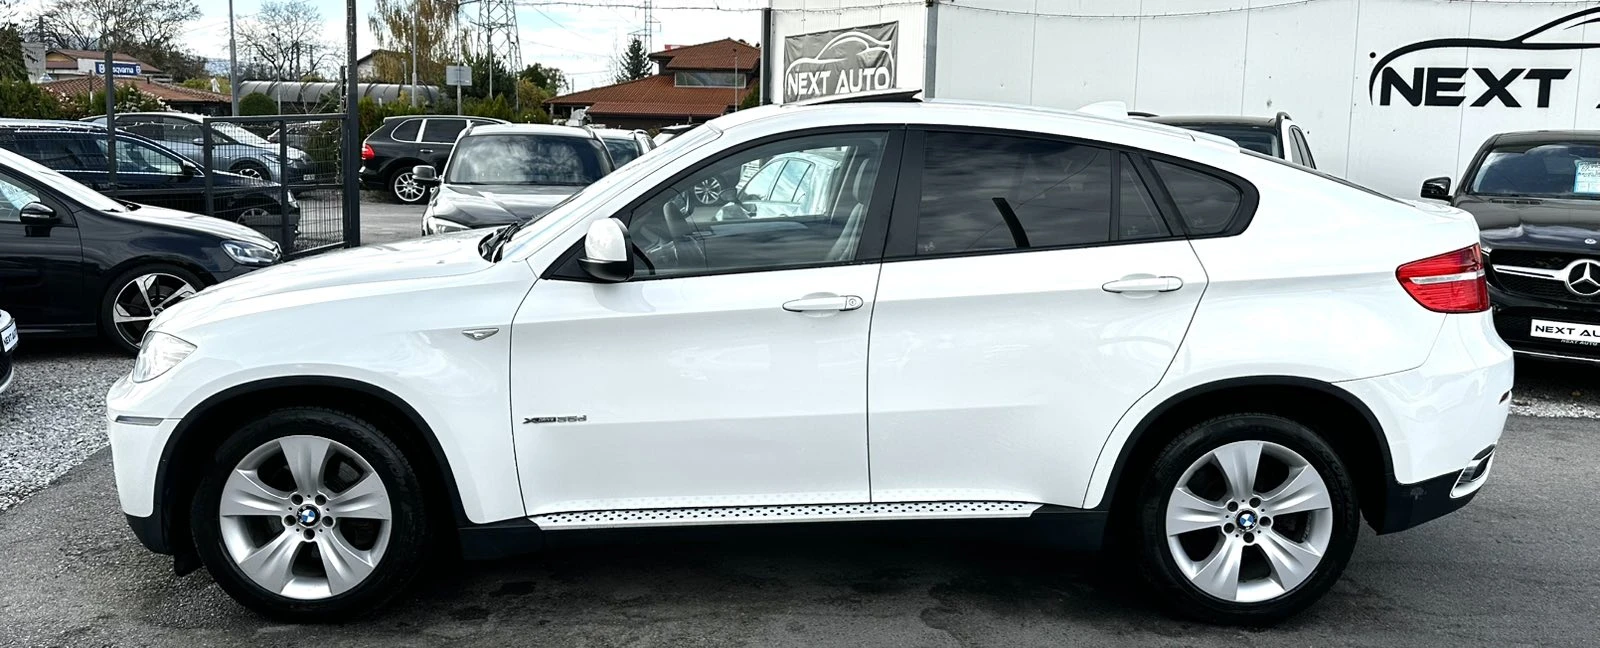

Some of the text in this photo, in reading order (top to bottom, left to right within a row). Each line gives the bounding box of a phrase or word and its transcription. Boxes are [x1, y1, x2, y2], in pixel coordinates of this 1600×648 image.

[788, 66, 890, 96] NEXT AUTO
[1379, 66, 1572, 108] NEXT
[1535, 325, 1575, 334] NEXT
